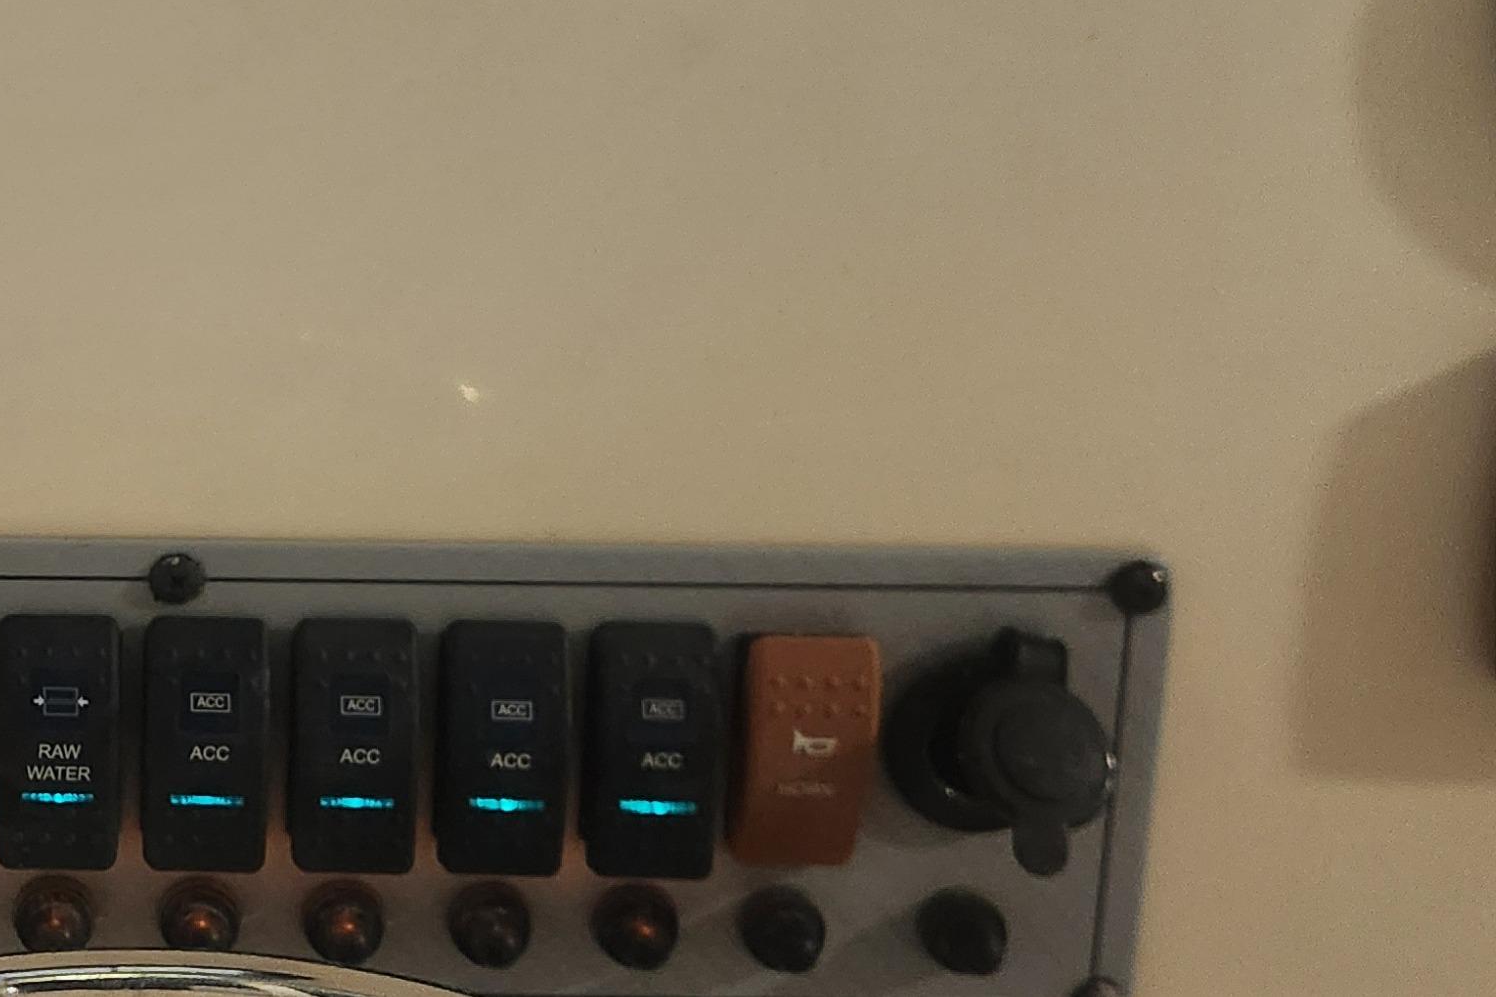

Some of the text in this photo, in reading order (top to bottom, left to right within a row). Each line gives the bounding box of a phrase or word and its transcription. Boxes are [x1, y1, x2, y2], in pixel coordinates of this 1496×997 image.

[197, 697, 225, 708] ACC
[347, 700, 375, 711] ACC
[498, 704, 527, 716] ACC
[38, 744, 81, 759] RAW
[190, 746, 230, 761] ACC
[340, 749, 380, 764] ACC
[491, 753, 531, 768] ACC
[641, 752, 682, 768] ACC
[27, 766, 91, 781] WATER
